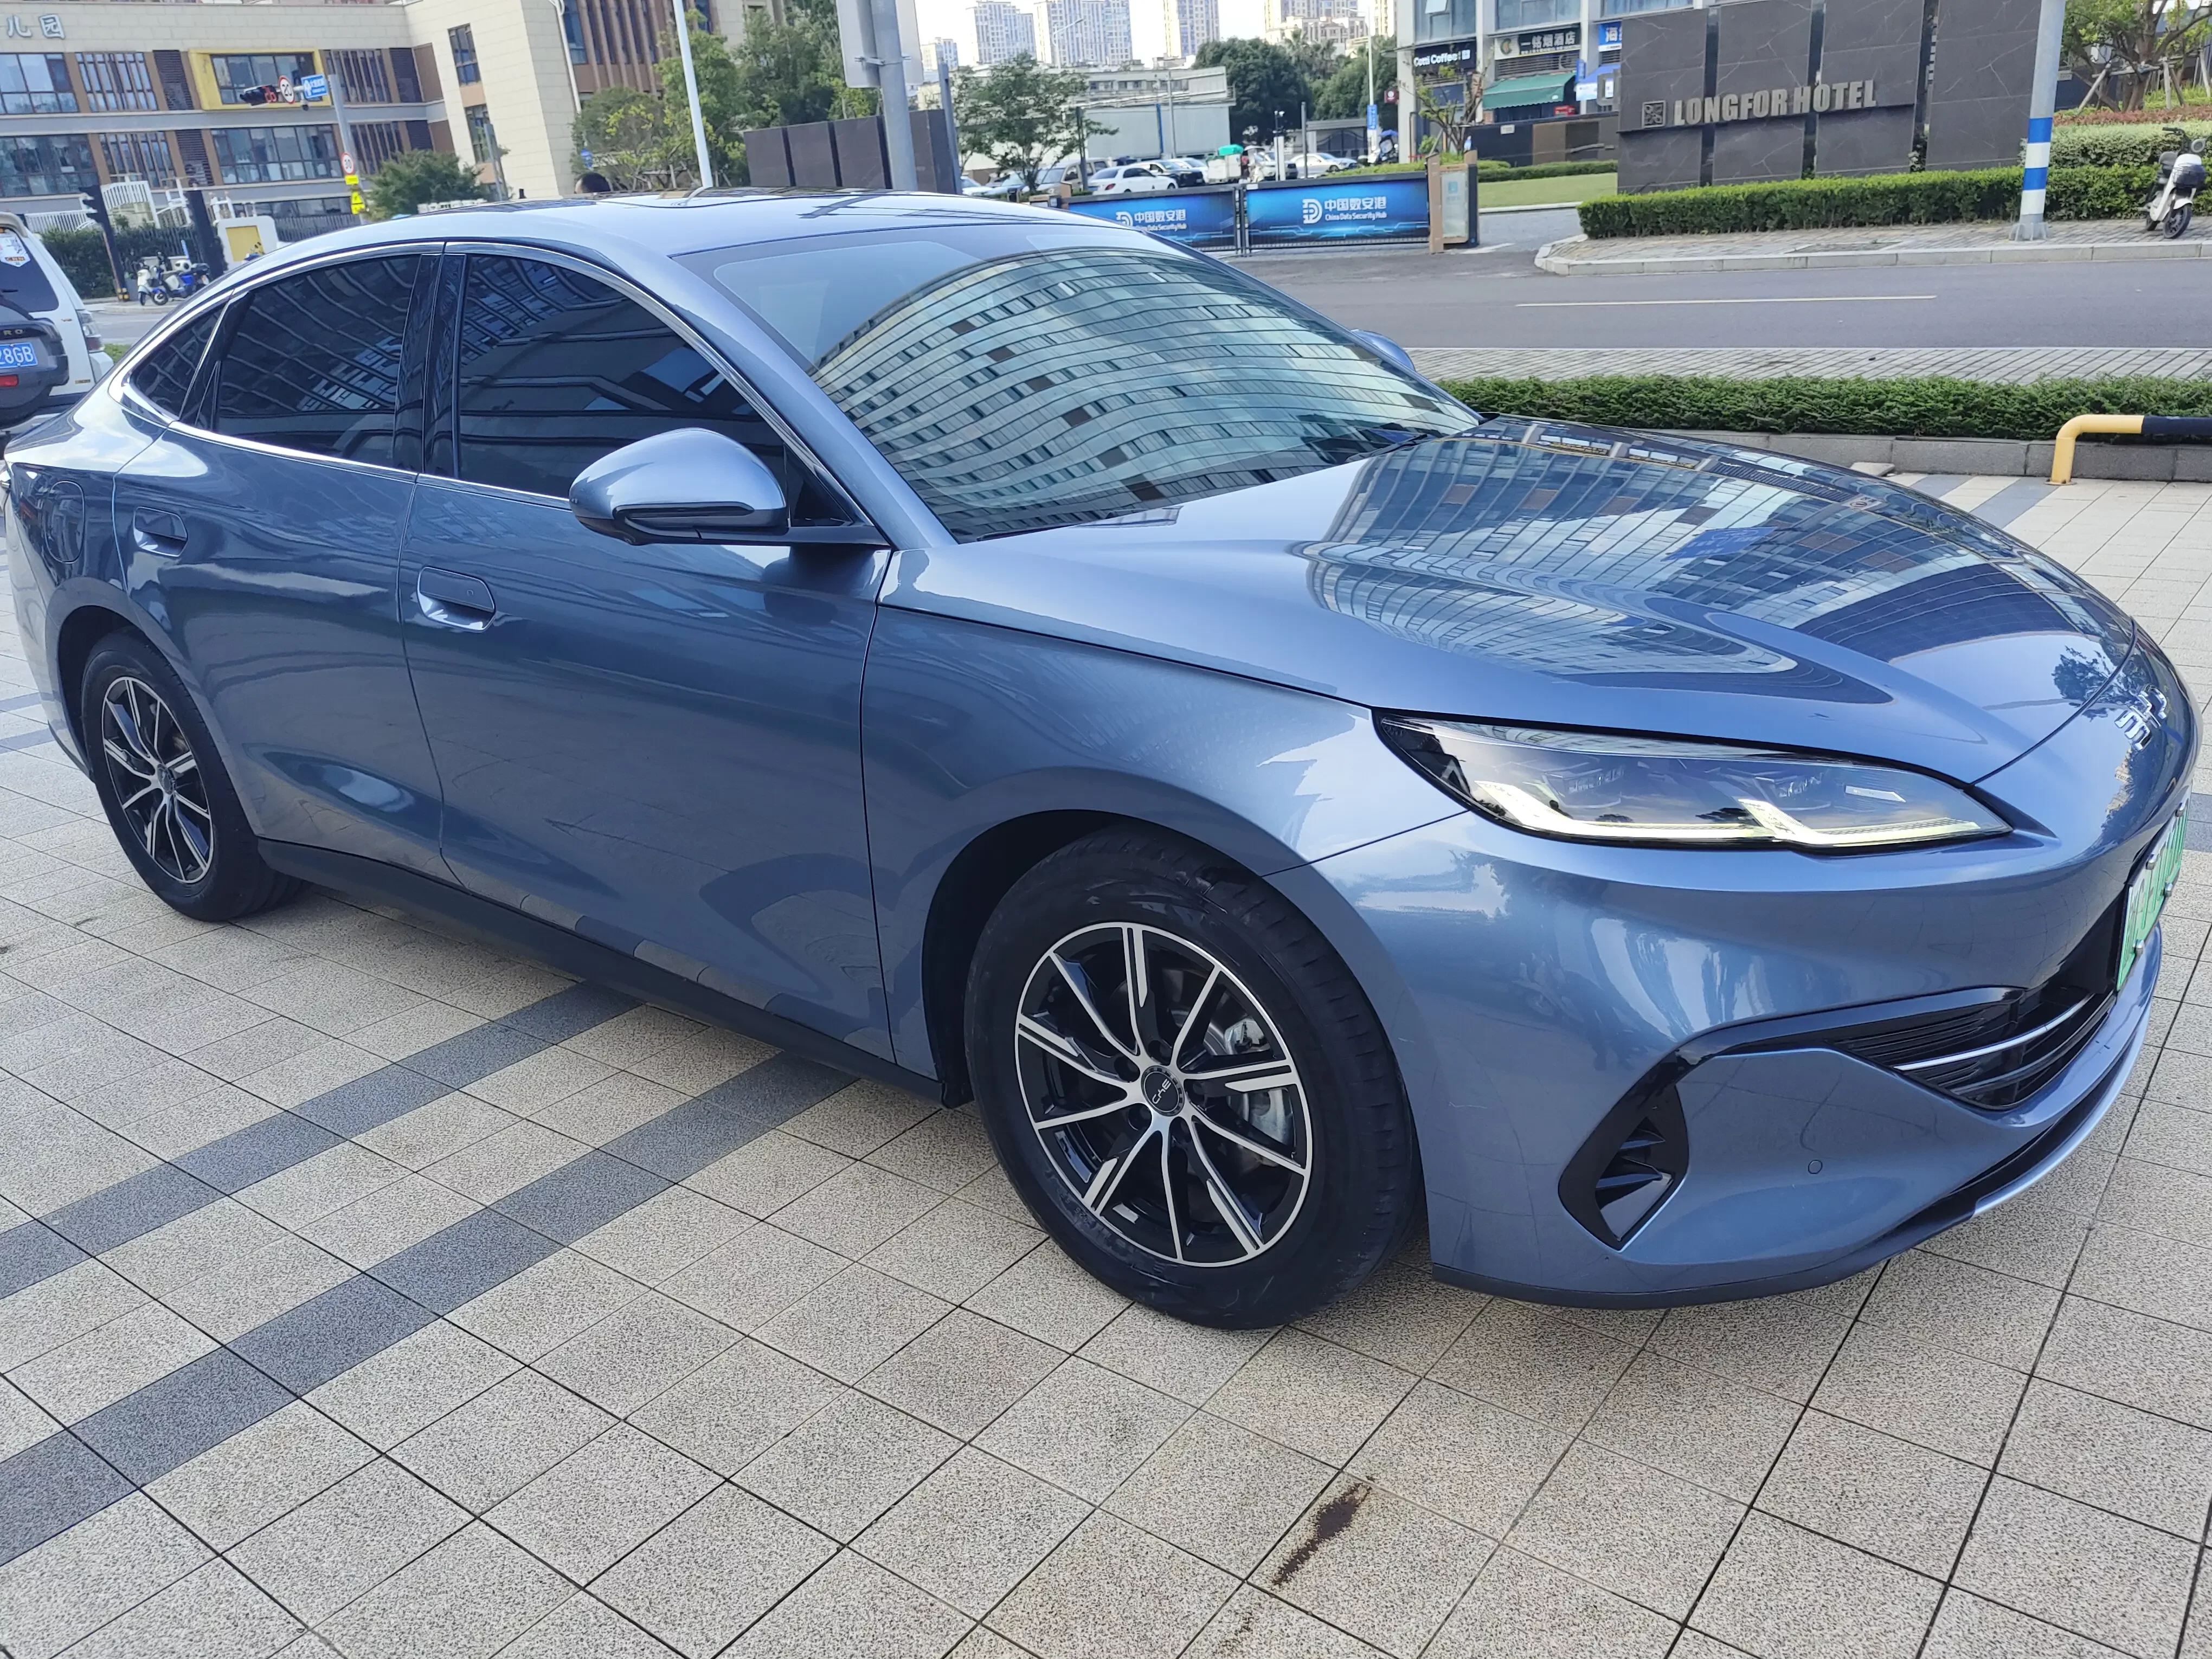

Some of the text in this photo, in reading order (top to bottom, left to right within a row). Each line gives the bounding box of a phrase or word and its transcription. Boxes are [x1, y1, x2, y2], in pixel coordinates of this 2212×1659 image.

[7, 13, 66, 40] 儿园
[1431, 53, 1458, 64] Coffee
[282, 83, 292, 97] 20
[1674, 79, 1877, 126] LONGFOR HOTEL
[1324, 196, 1386, 211] 中国数安港
[1134, 209, 1186, 223] 中国数安港
[1352, 211, 1375, 221] Security
